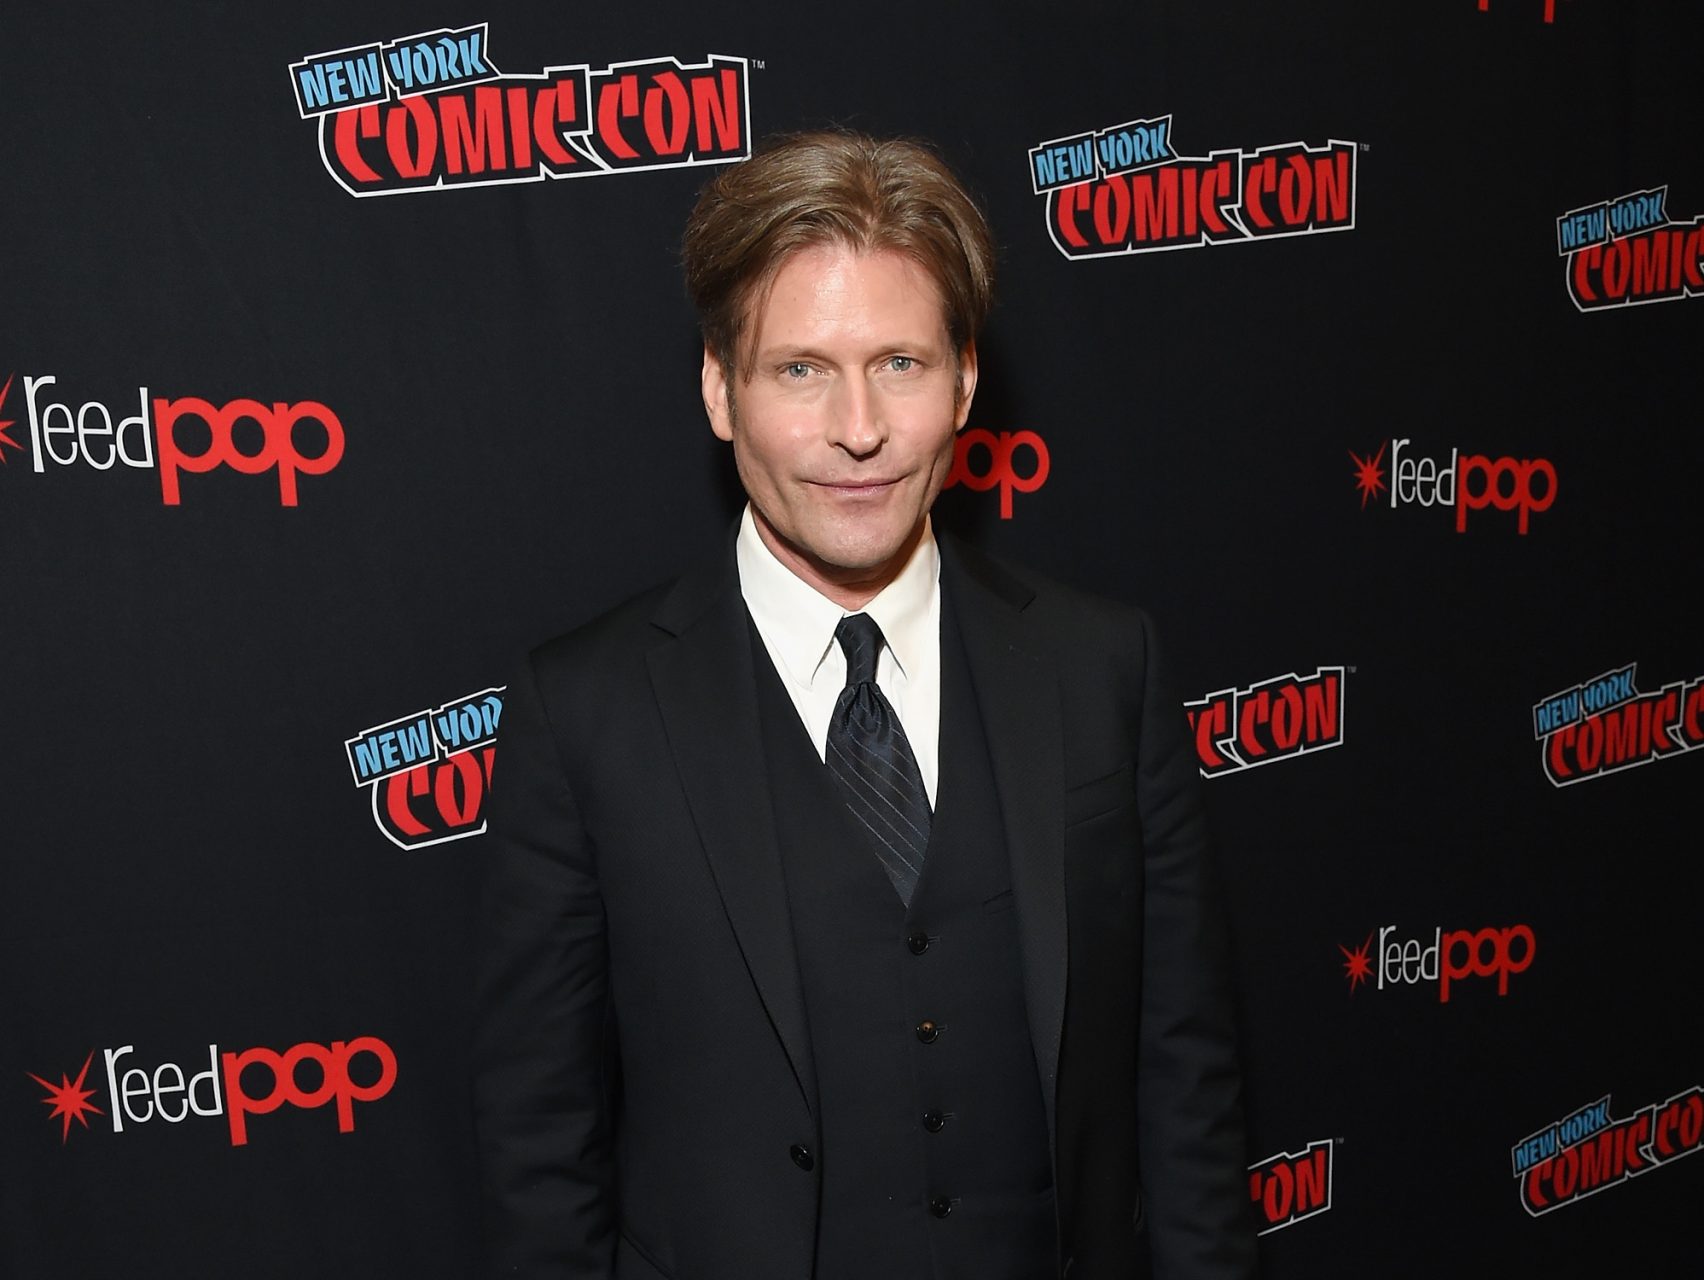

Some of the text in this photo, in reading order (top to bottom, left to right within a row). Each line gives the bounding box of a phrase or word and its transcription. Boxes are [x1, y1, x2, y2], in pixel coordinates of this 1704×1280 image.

[299, 33, 487, 109] NEW YORK
[334, 79, 577, 183] COMIC
[597, 69, 741, 161] CON
[1036, 123, 1169, 186] NEW YORK
[1057, 152, 1349, 248] COMIC CON
[1561, 193, 1664, 248] NEW YORK
[355, 696, 504, 778] NEW YOR
[1239, 676, 1338, 757] CON
[1538, 671, 1632, 732] NEW YORK
[1550, 692, 1677, 777] COMIC
[1516, 1103, 1607, 1170] NEW YORK
[1528, 1094, 1704, 1207] COMIC CO
